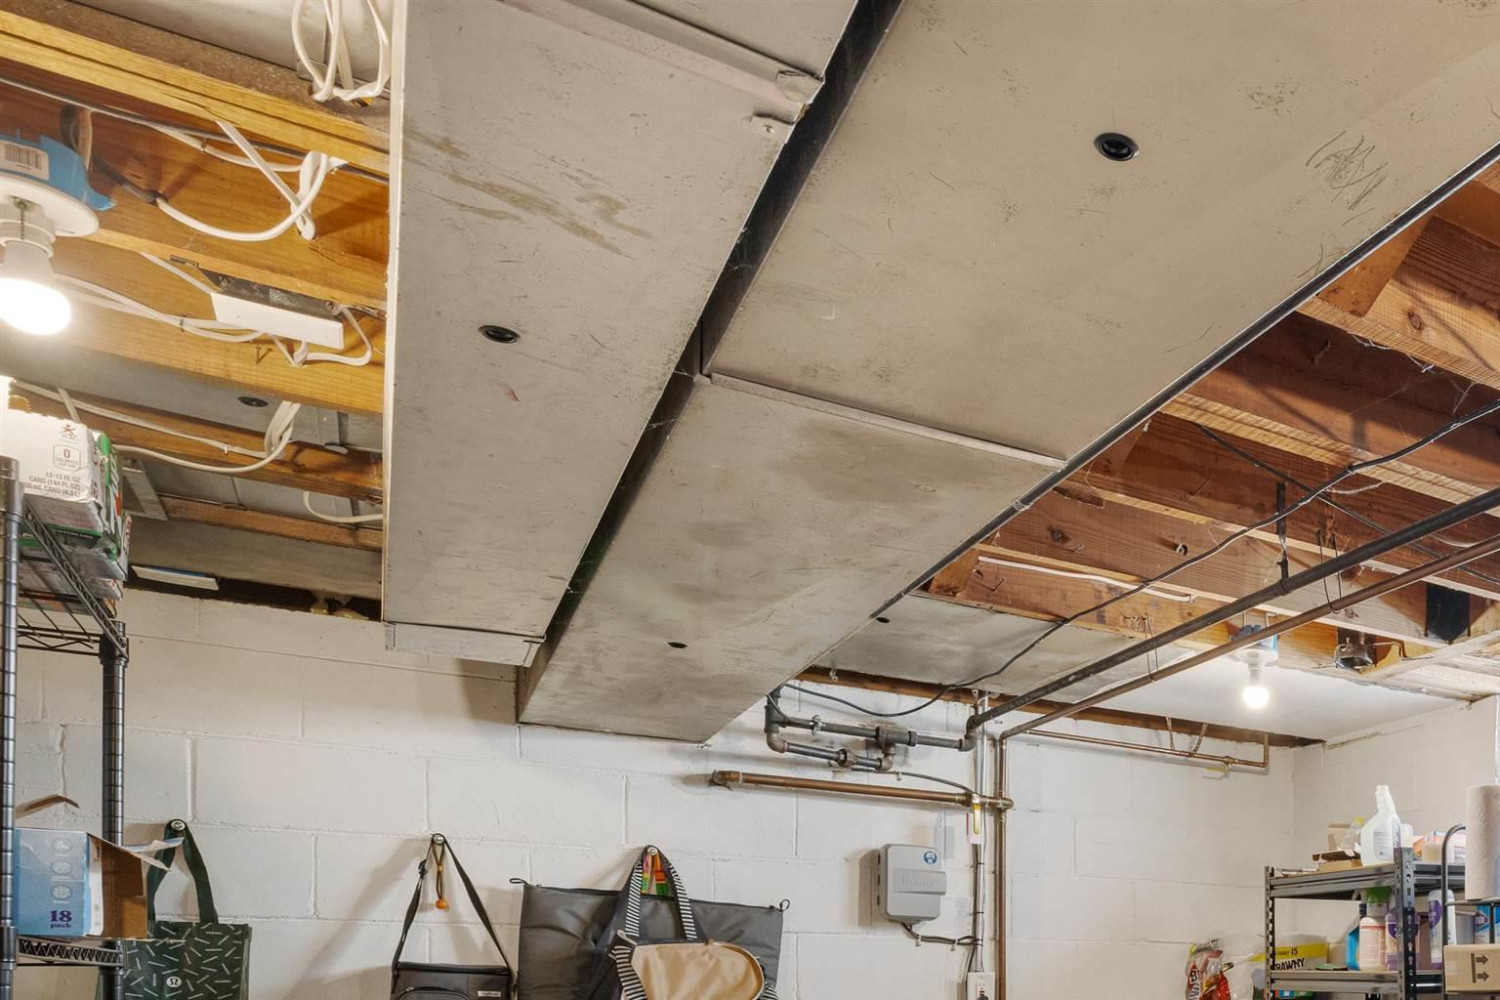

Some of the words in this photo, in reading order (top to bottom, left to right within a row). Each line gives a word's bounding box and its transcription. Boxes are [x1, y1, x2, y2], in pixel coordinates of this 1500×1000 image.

[50, 910, 73, 922] 18
[1291, 947, 1298, 955] 15
[1275, 958, 1305, 970] RAWNY
